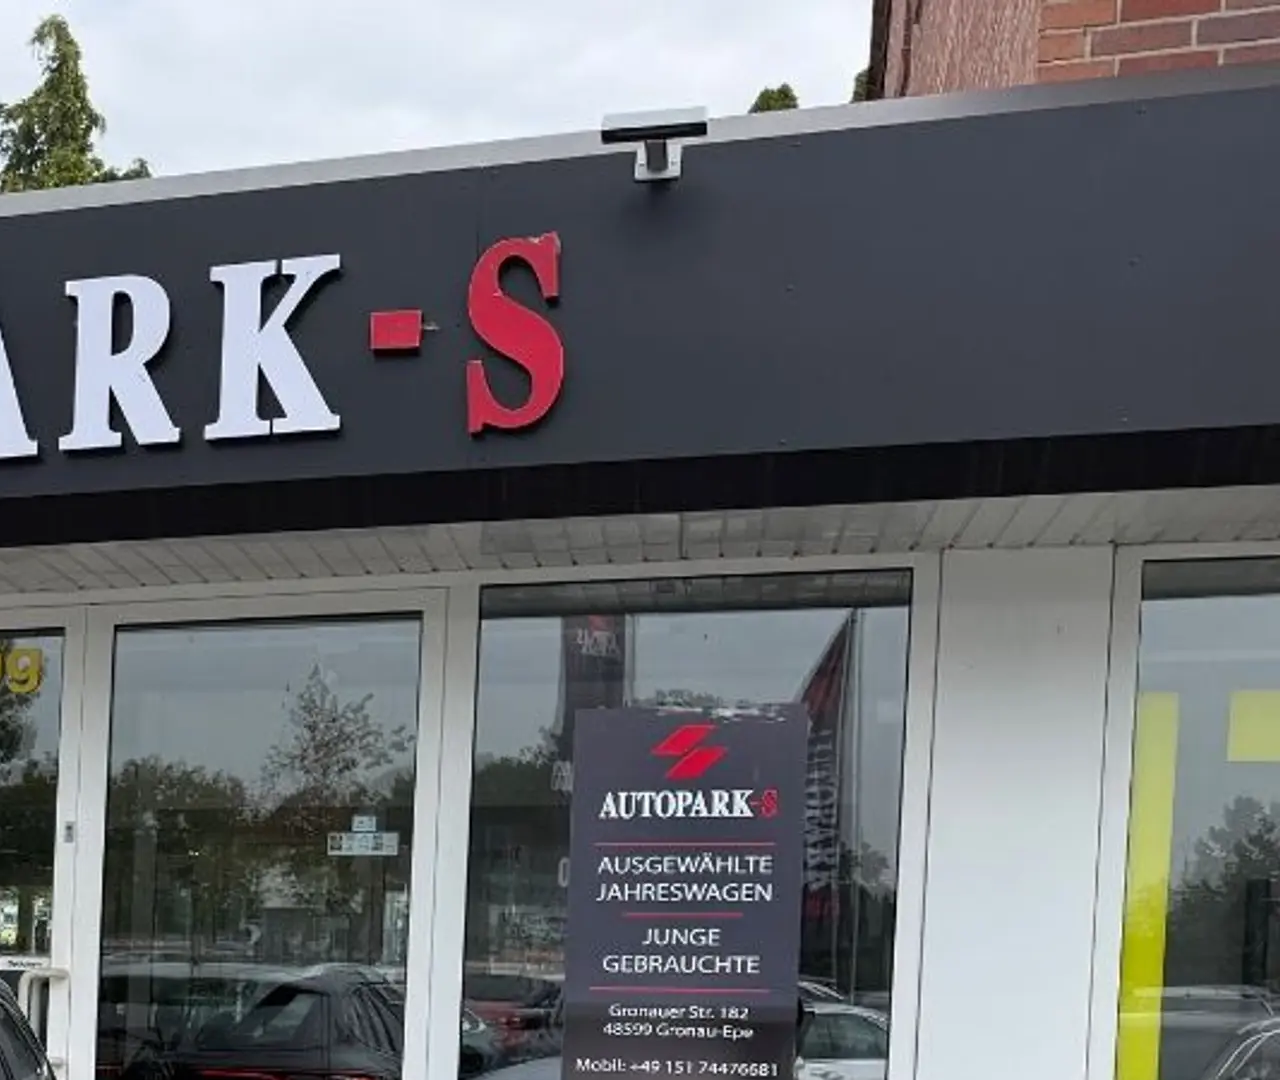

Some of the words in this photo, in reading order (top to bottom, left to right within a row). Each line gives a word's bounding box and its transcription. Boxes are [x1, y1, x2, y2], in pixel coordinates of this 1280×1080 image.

[598, 788, 779, 819] AUTOPARK-S
[597, 853, 773, 875] AUSGEWÄHLTE
[596, 883, 773, 902] JAHRESWAGEN
[642, 929, 721, 947] JUNGE
[602, 955, 761, 974] GEBRAUCHTE
[608, 1003, 685, 1019] Gronauer
[689, 1005, 715, 1019] Str.
[720, 1006, 749, 1020] 182
[603, 1022, 652, 1036] 48599
[574, 1057, 627, 1073] Mobil:
[666, 1061, 692, 1075] 151
